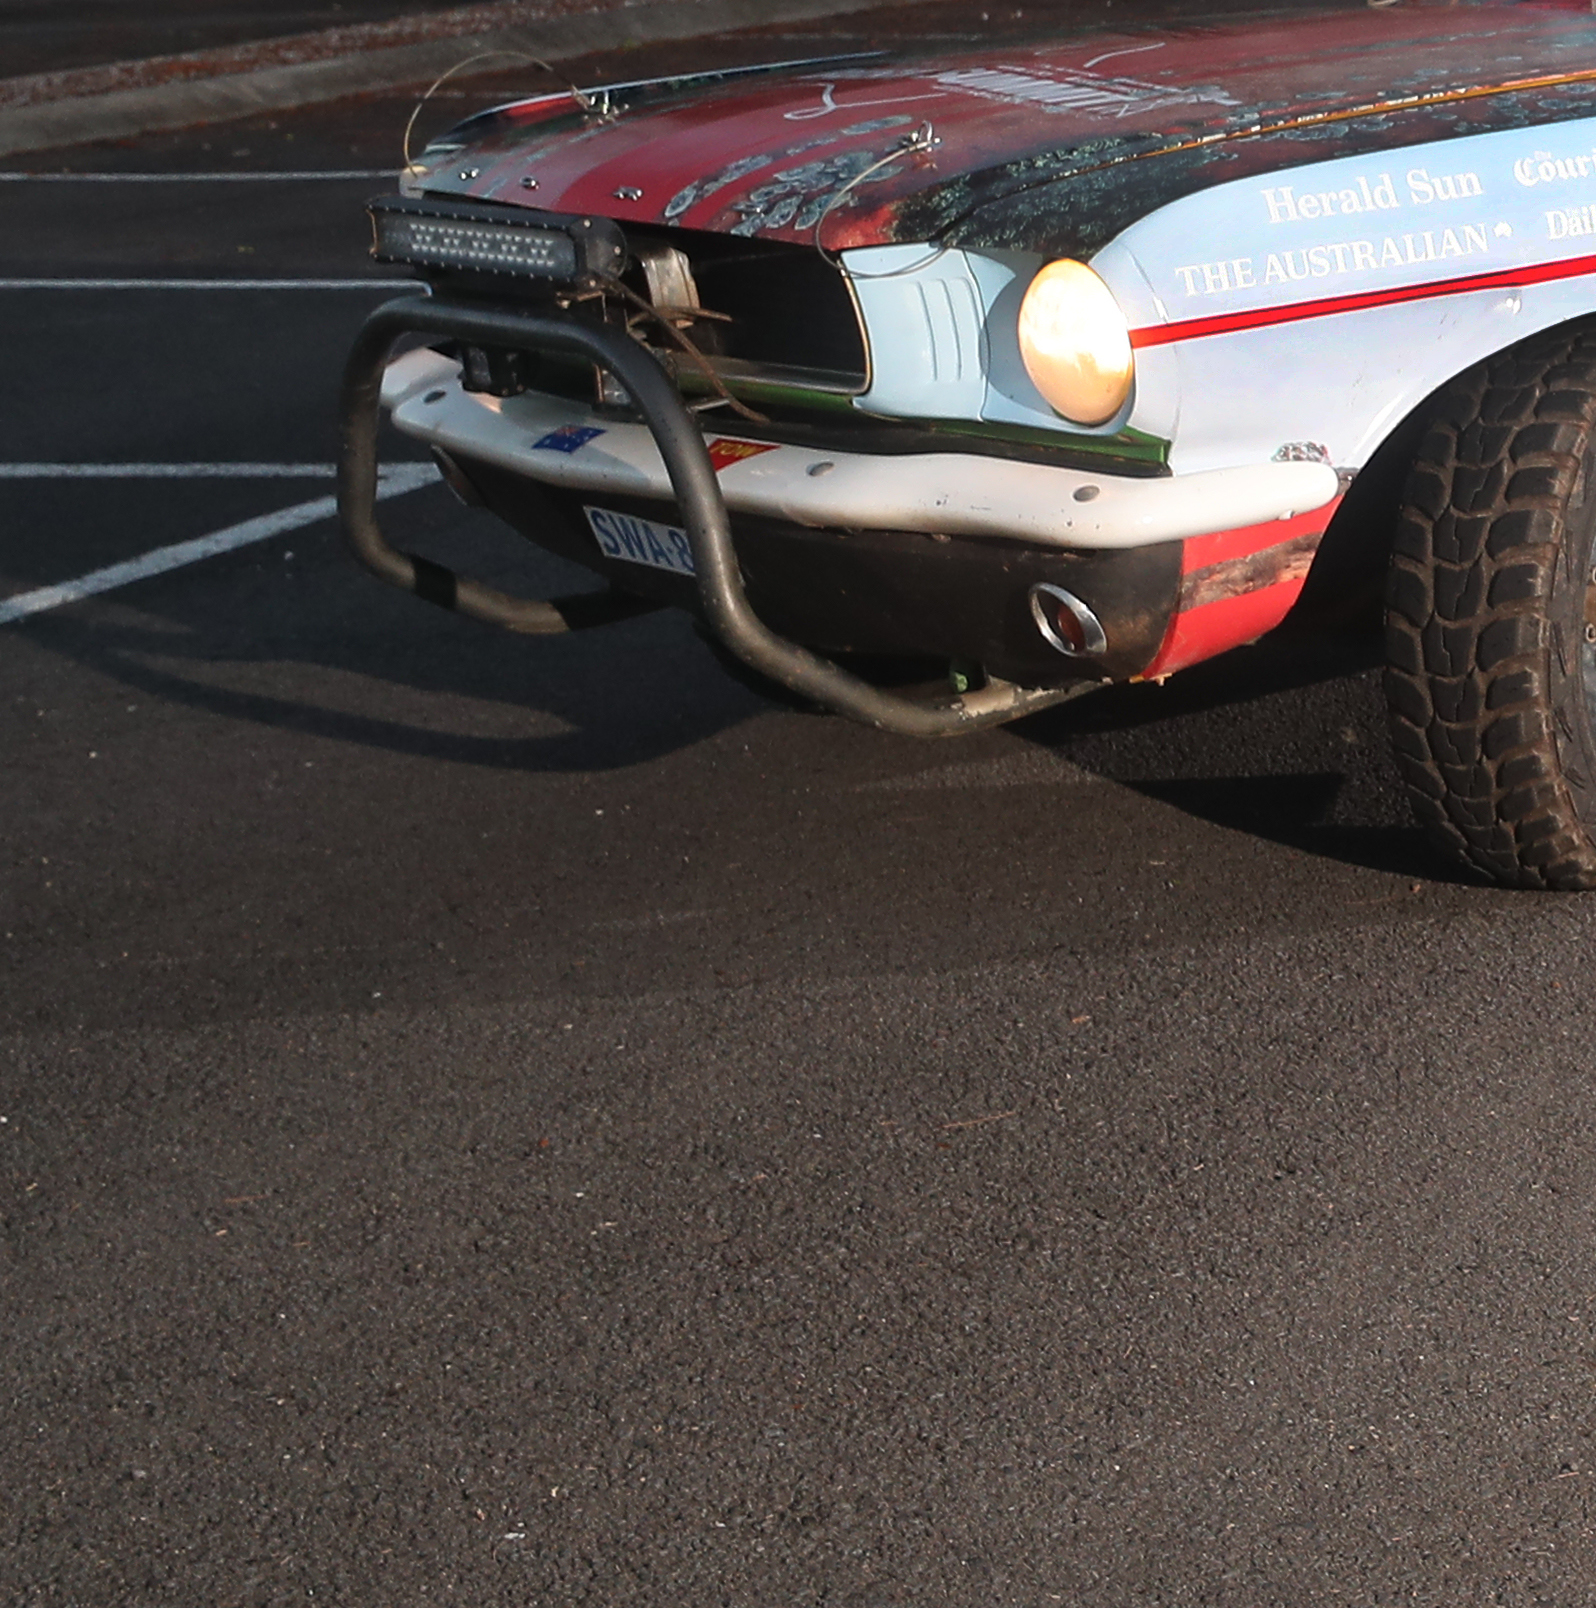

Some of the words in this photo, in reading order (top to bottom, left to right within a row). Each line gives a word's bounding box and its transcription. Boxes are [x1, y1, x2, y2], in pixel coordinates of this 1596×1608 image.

[1261, 172, 1400, 224] Herald
[1406, 168, 1485, 205] Sun
[1174, 258, 1258, 298] THE
[1263, 221, 1490, 286] AUSTRALIAN
